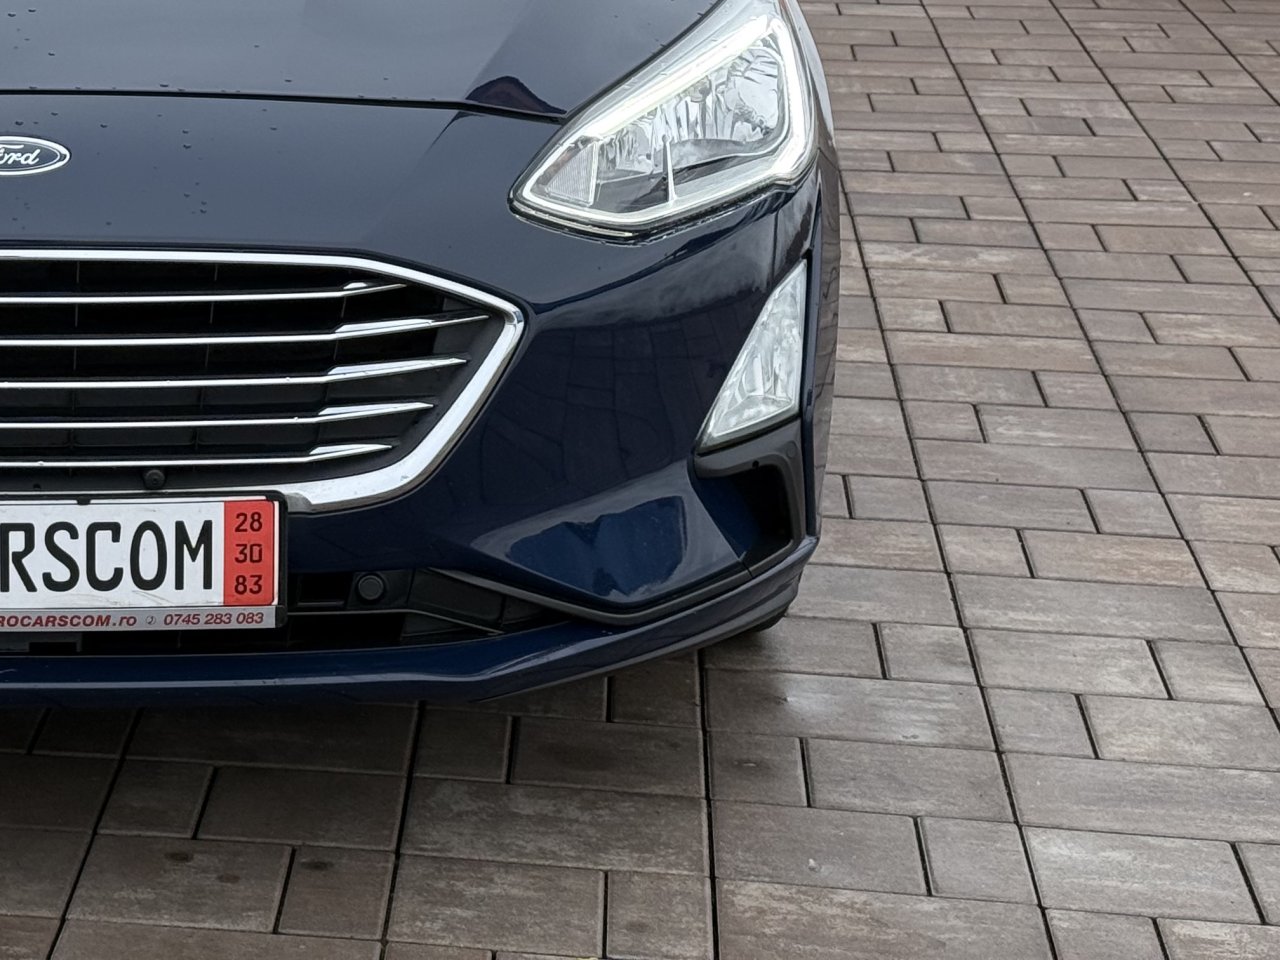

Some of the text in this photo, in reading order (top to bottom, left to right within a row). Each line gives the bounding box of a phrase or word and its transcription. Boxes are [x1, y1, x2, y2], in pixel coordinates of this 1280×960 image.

[234, 511, 263, 533] 28
[234, 543, 263, 564] 30
[234, 574, 263, 595] 83
[163, 613, 200, 626] 0745
[204, 613, 232, 625] 283
[236, 612, 265, 625] 083
